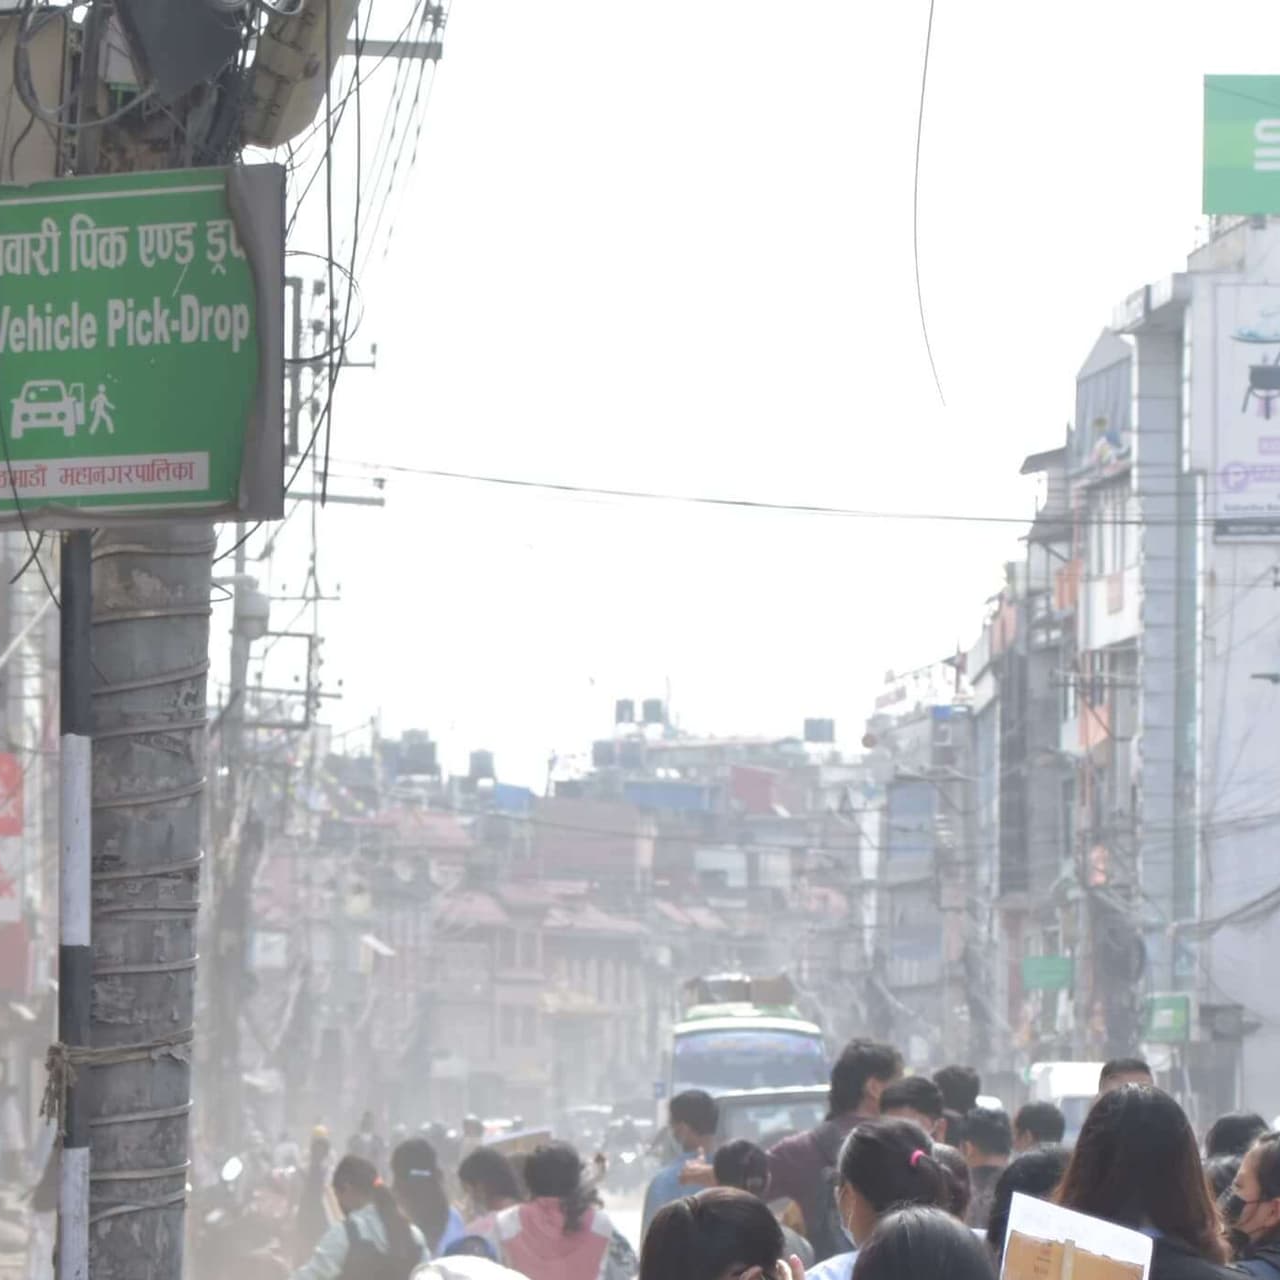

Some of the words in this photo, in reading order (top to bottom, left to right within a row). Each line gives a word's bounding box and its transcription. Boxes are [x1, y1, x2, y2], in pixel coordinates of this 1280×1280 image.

[71, 213, 129, 272] पिक
[138, 221, 197, 268] एण्ड
[107, 294, 250, 353] Pick-Drop
[58, 458, 196, 486] महानगरपालिका
